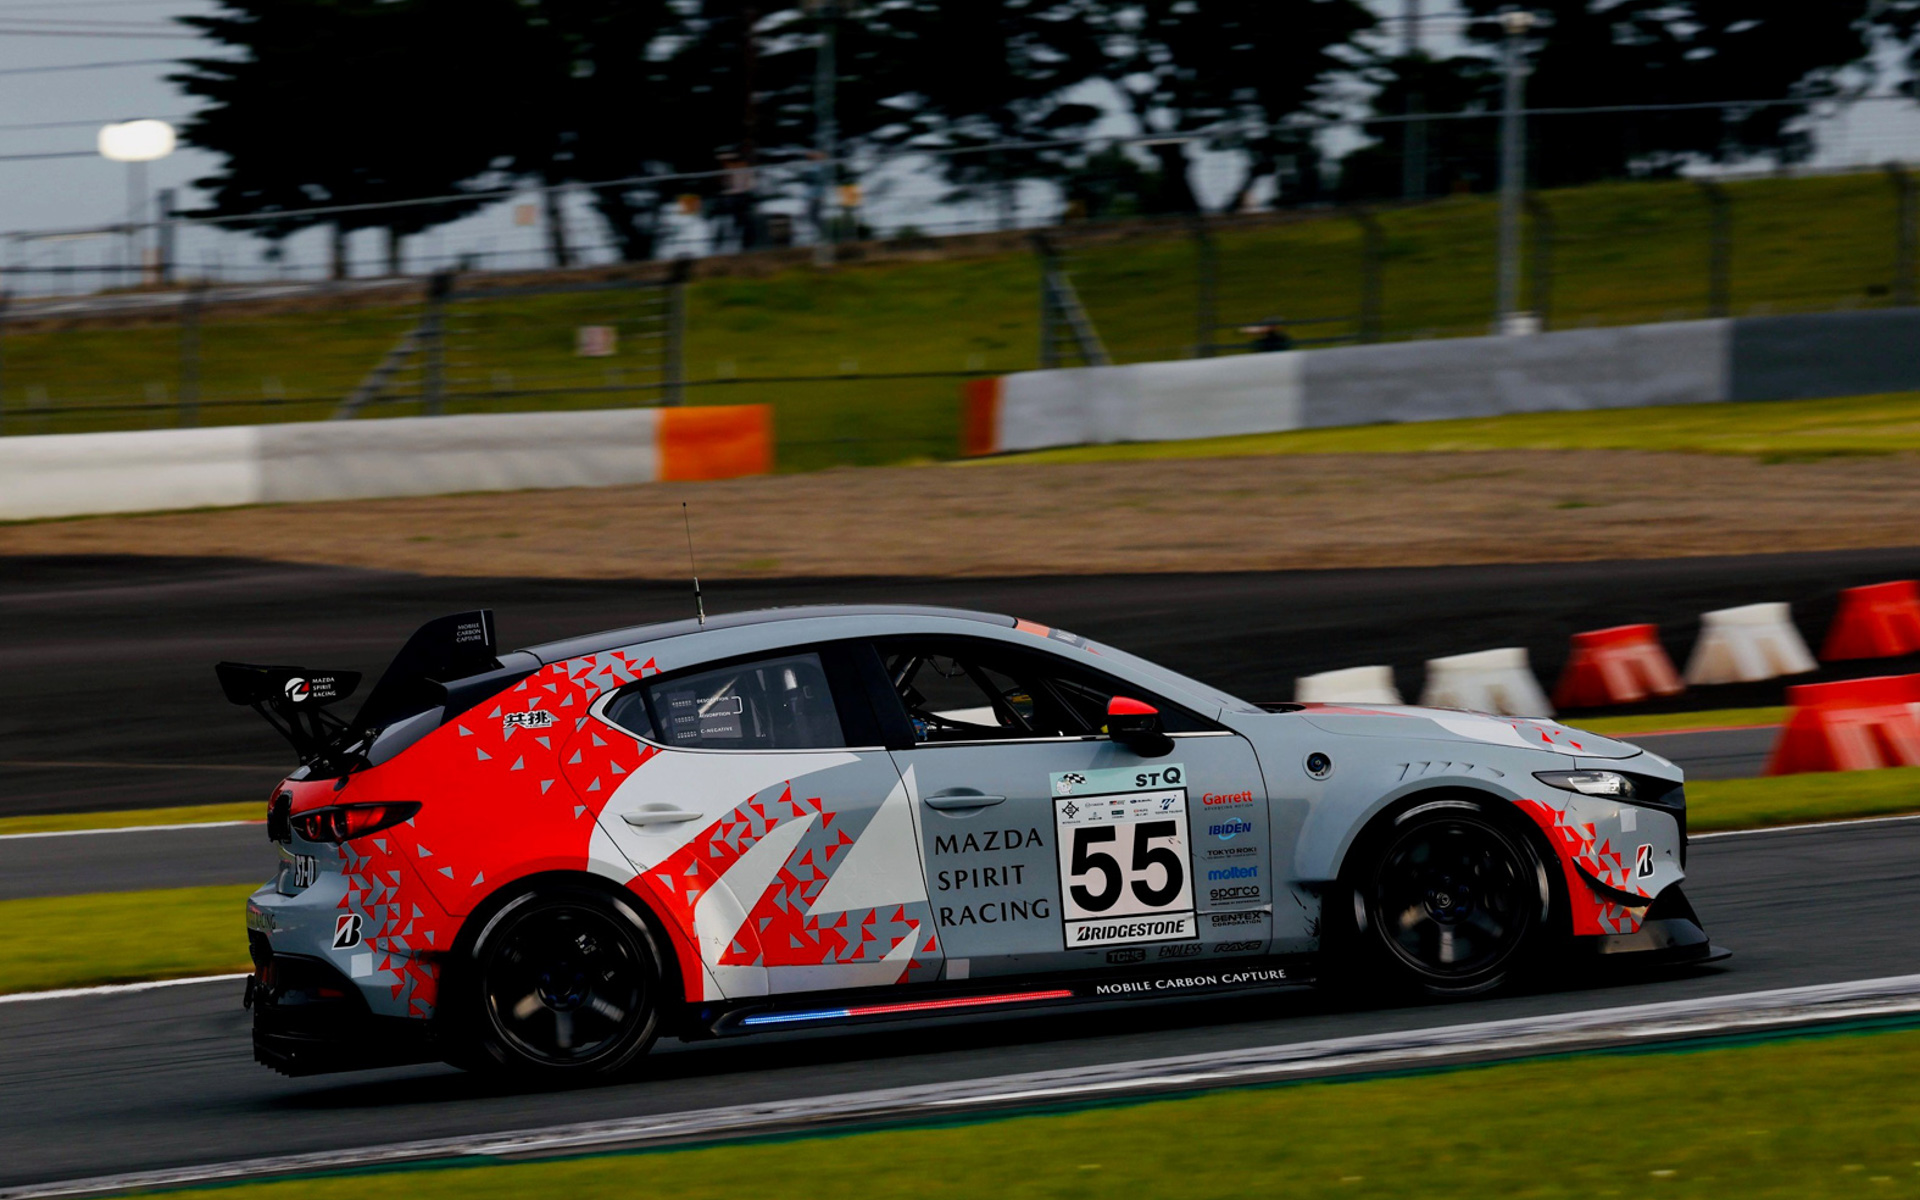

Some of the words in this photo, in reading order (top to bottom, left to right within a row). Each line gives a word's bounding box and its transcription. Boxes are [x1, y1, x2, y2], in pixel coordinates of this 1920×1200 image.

[456, 629, 481, 637] CARBON
[1202, 790, 1253, 806] Garrett
[1208, 822, 1252, 836] IBIDEN
[935, 827, 1044, 856] MAZDA
[1207, 848, 1236, 856] TOKYO
[1070, 820, 1184, 912] 55
[1208, 866, 1258, 881] molten
[938, 864, 1025, 891] SPIRIT
[1210, 885, 1260, 900] sparco
[940, 898, 1050, 927] RACING
[1211, 911, 1262, 923] GENTEX
[1077, 919, 1185, 942] BRIDGESTONE
[1158, 942, 1203, 958] ENDLESS
[1096, 980, 1152, 995] MOBILE
[1154, 974, 1217, 990] CARBON
[1221, 968, 1287, 984] CAPTURE
